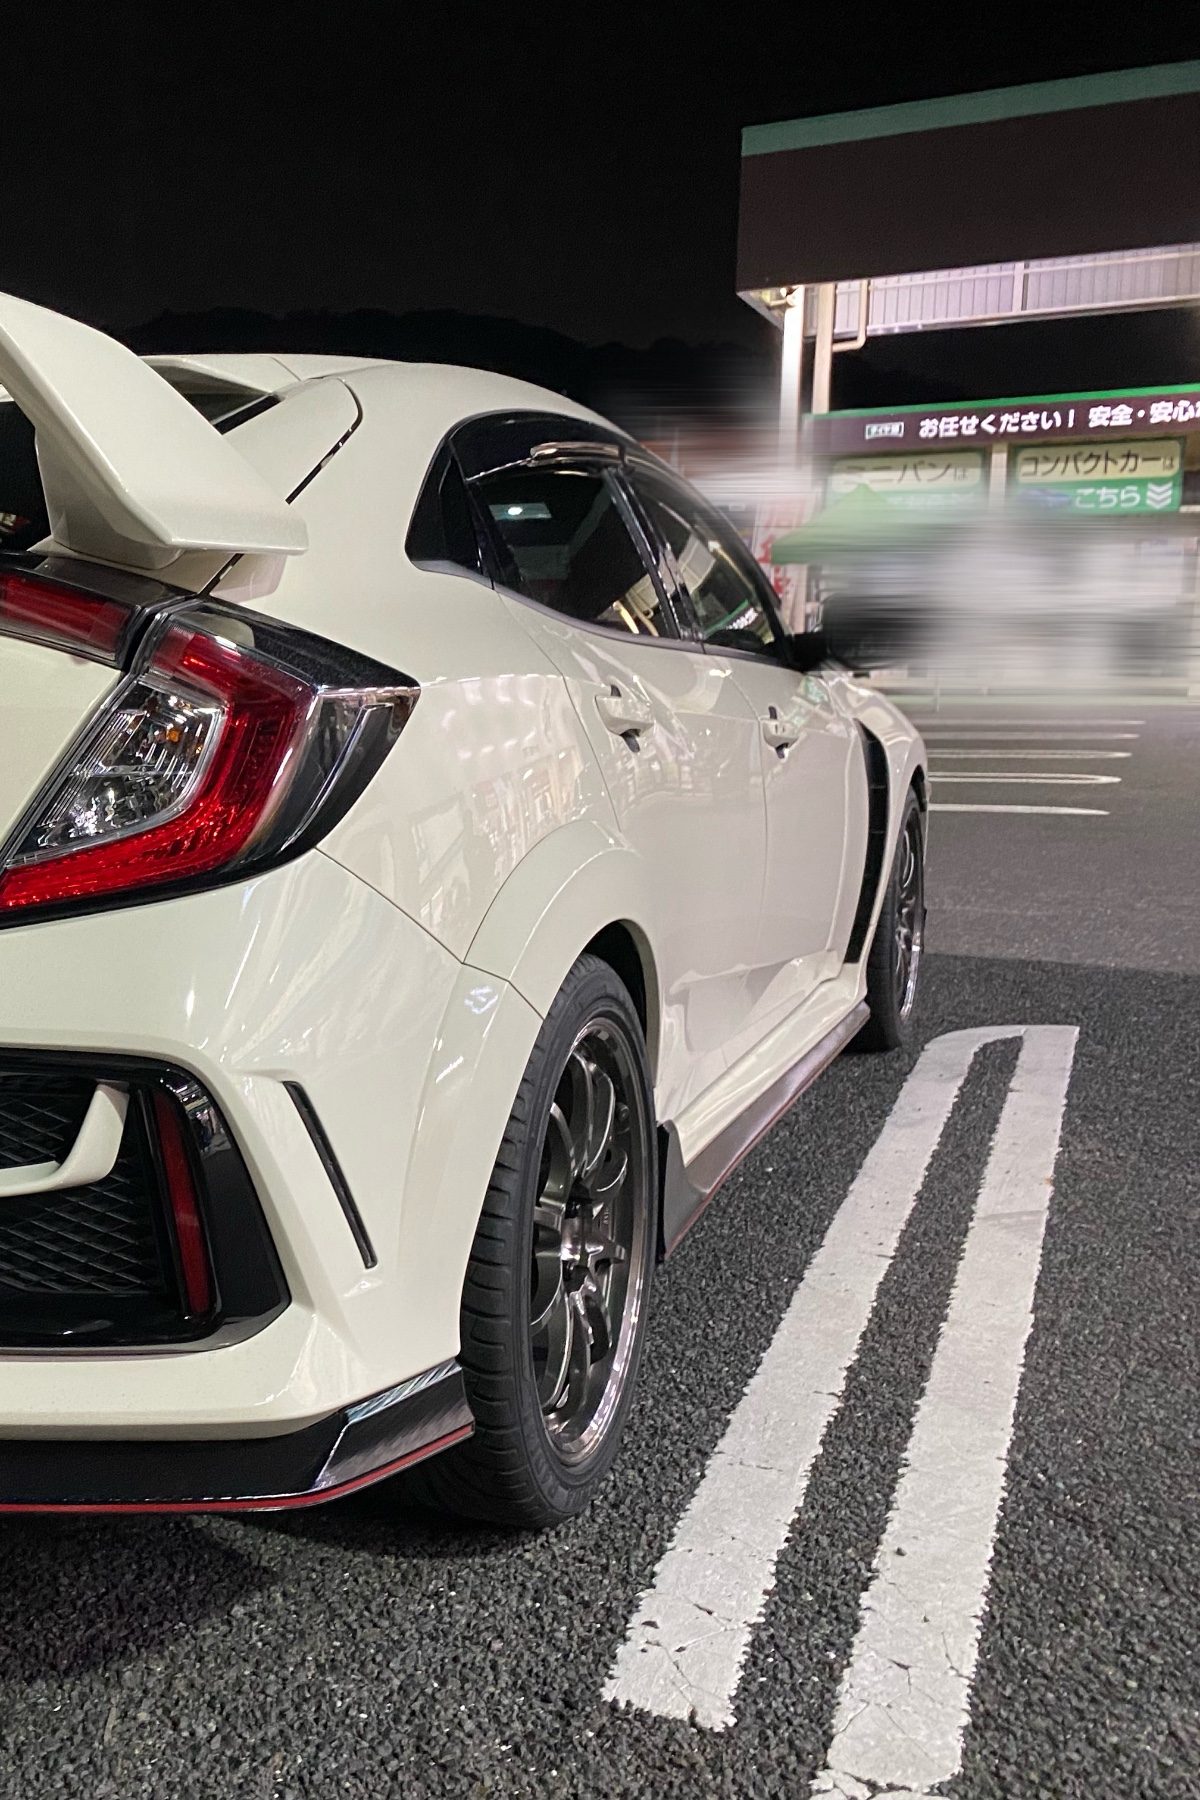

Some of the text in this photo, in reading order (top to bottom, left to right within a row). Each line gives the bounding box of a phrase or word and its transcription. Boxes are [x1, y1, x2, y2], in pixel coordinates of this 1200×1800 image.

[1088, 400, 1200, 428] 安全・安心
[1075, 486, 1140, 508] こちら
